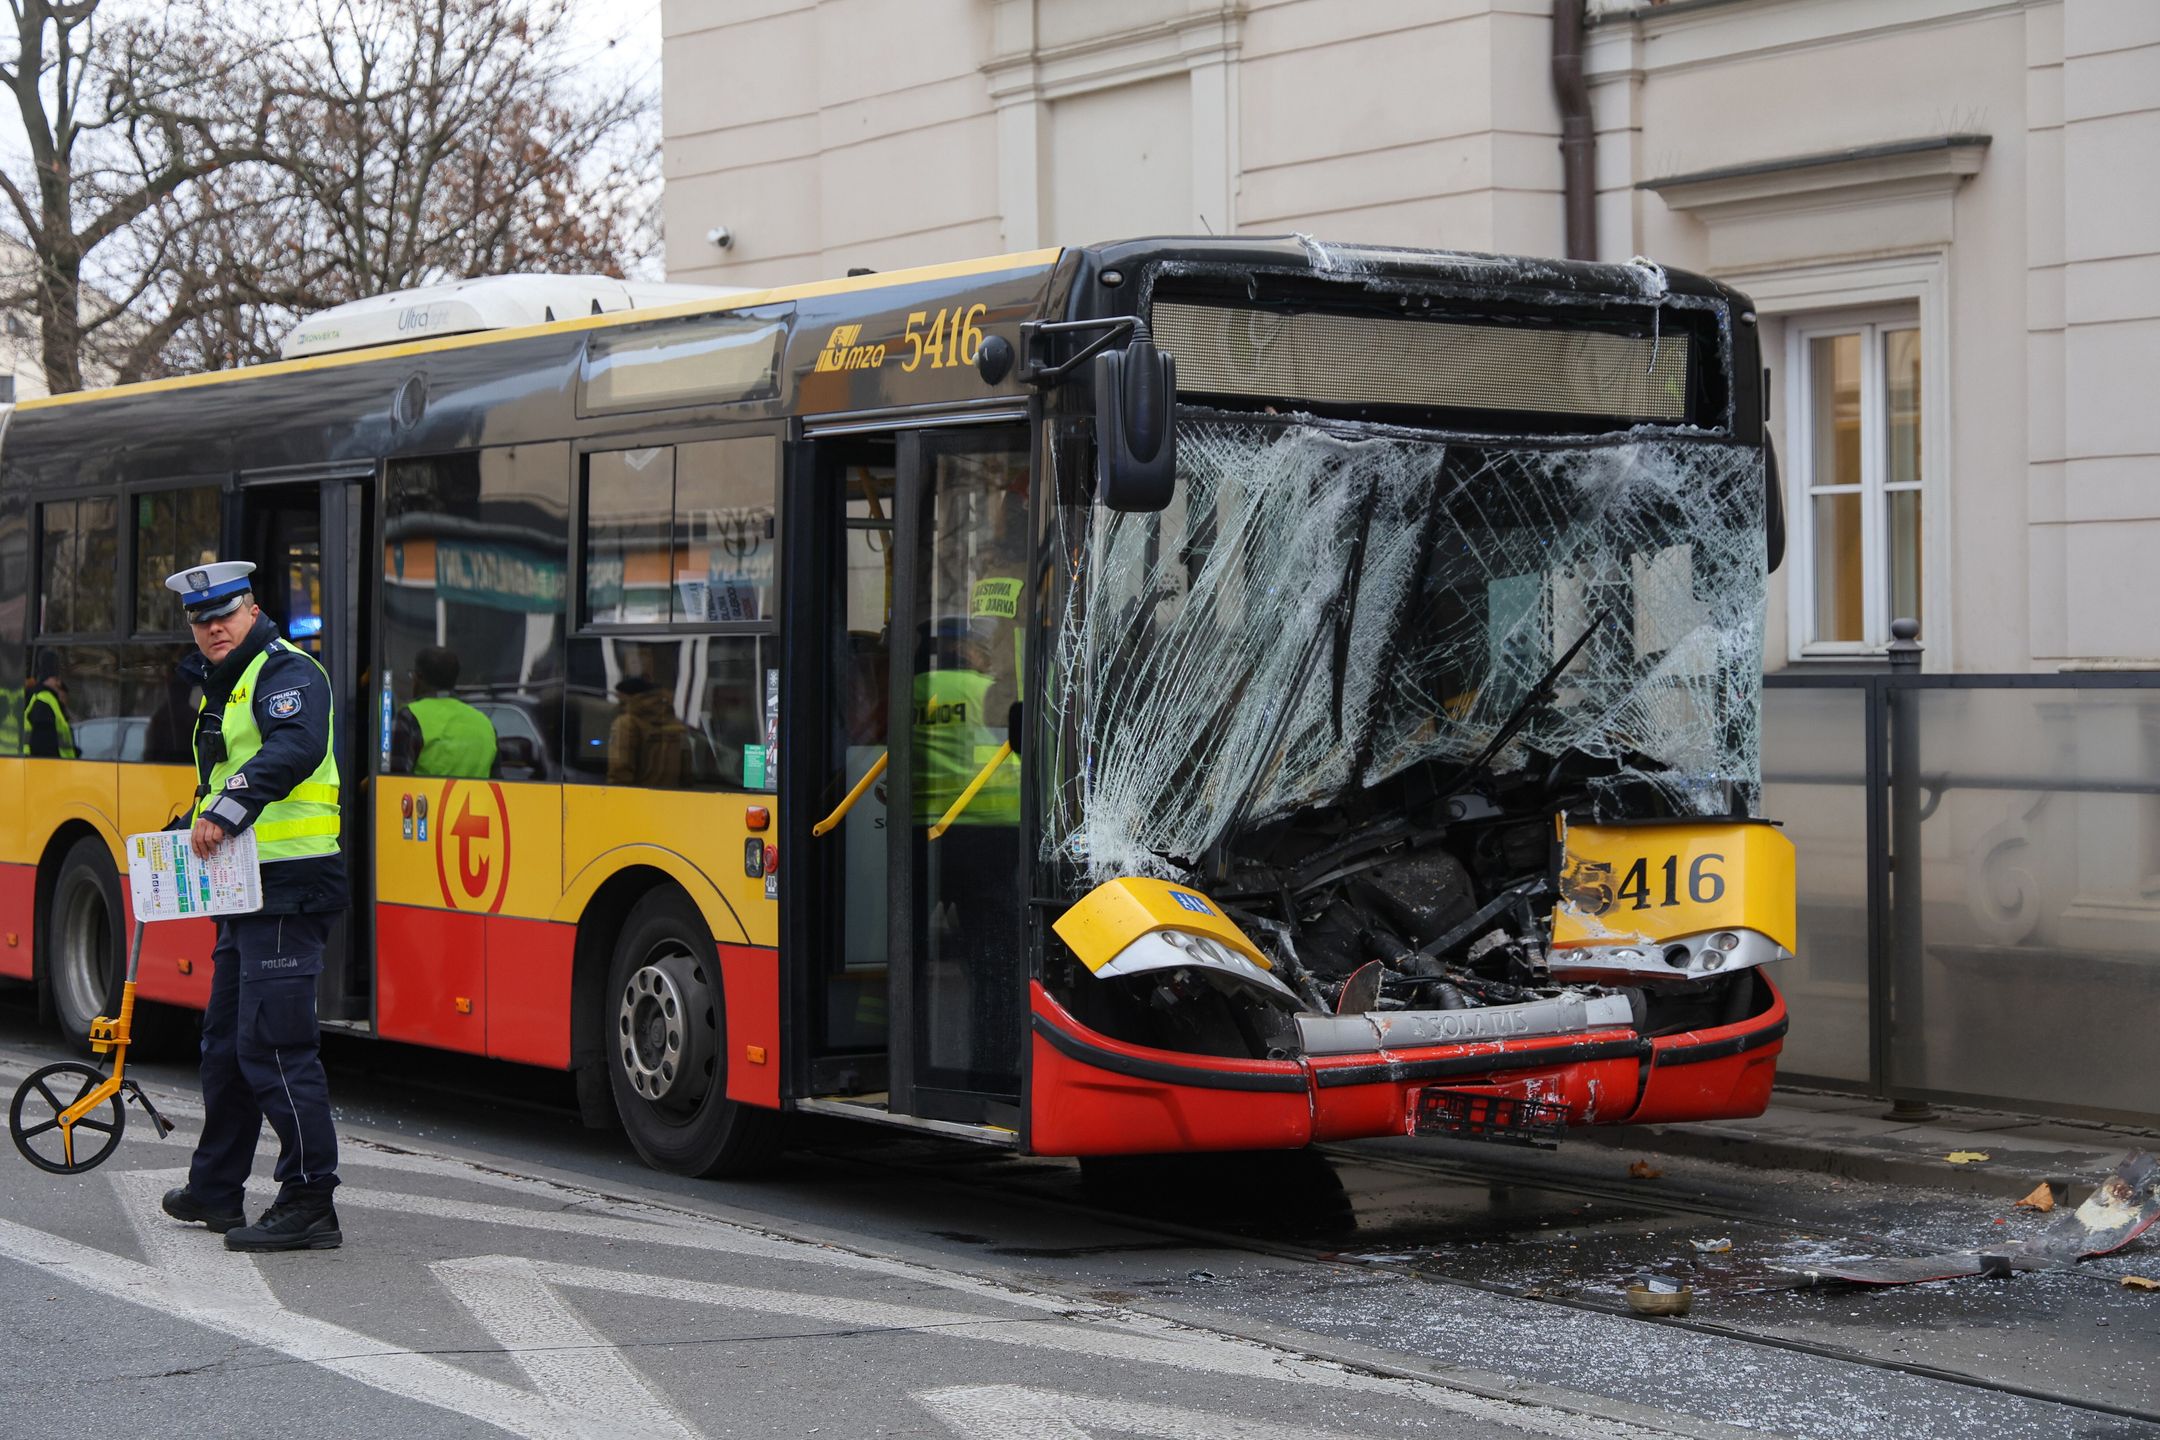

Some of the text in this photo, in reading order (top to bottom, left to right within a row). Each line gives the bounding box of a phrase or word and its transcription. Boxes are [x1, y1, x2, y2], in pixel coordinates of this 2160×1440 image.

[901, 303, 987, 373] 5416
[272, 690, 298, 701] POLICJA
[1576, 853, 1725, 916] 5416
[261, 958, 298, 969] POLICJA
